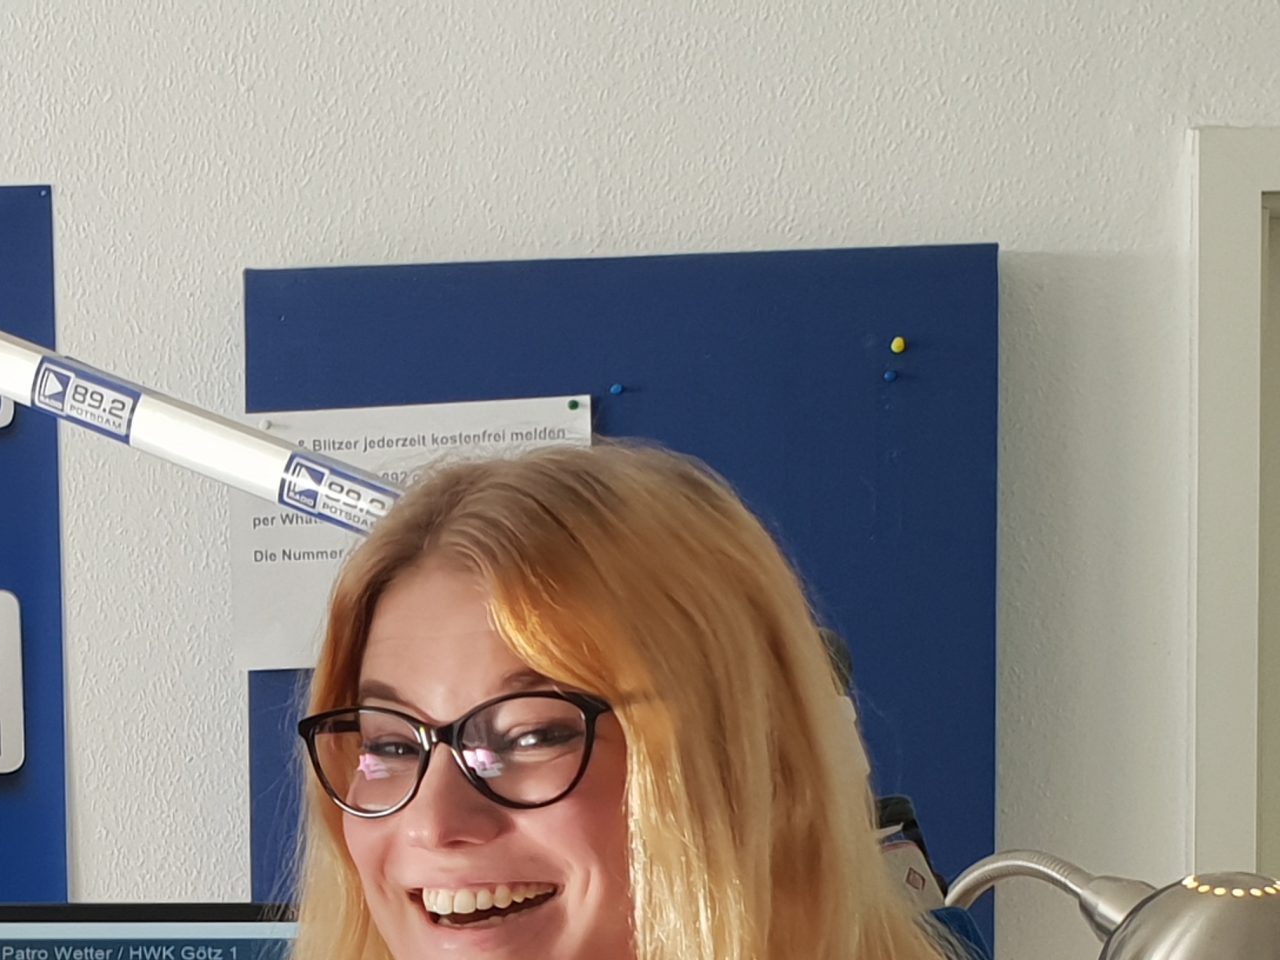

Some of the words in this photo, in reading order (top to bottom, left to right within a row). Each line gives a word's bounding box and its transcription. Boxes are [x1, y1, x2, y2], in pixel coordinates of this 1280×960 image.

[71, 383, 128, 420] 89.2
[69, 403, 122, 431] POTSDAM
[313, 438, 359, 452] Blitzer
[363, 434, 426, 453] jederzeit
[431, 430, 506, 446] kostenfrei
[511, 427, 566, 443] melden
[253, 515, 275, 529] per
[254, 549, 277, 562] Die
[282, 548, 344, 561] Nummer
[129, 946, 175, 960] HWK
[229, 946, 238, 960] 1
